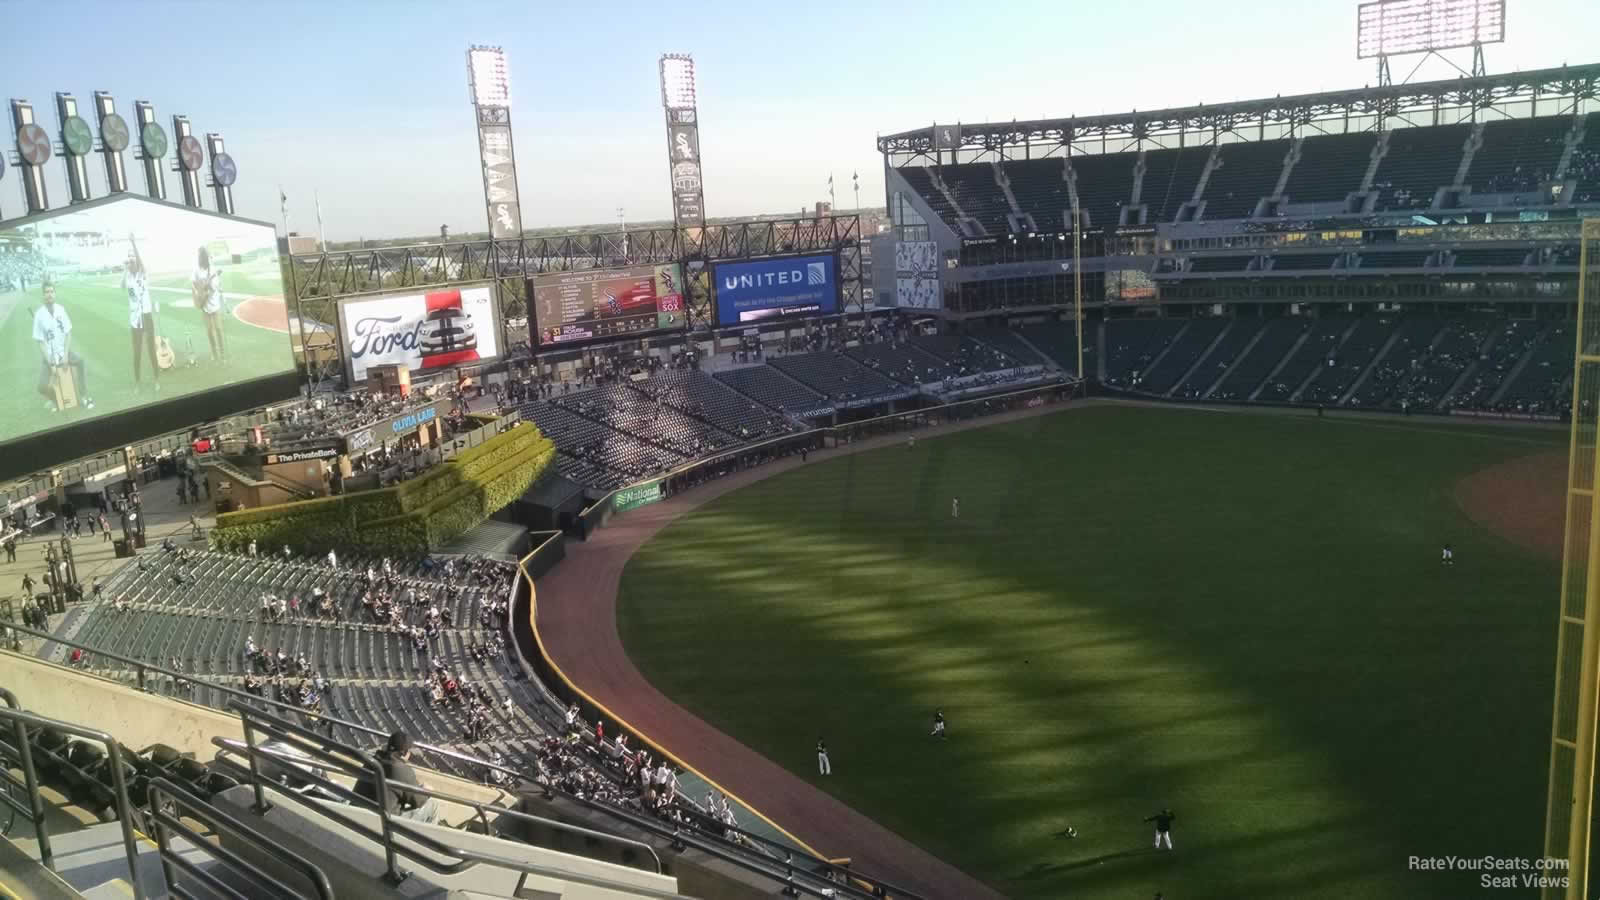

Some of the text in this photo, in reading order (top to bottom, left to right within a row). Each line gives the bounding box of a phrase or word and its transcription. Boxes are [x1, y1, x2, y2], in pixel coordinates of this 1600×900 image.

[725, 270, 803, 290] UNITED
[662, 304, 679, 312] SOX
[351, 315, 424, 359] Ford
[552, 327, 561, 336] 31
[802, 406, 836, 417] HYUNDAI
[392, 415, 417, 433] OLIVIA
[278, 448, 337, 462] The PrivateBank
[626, 484, 660, 503] National
